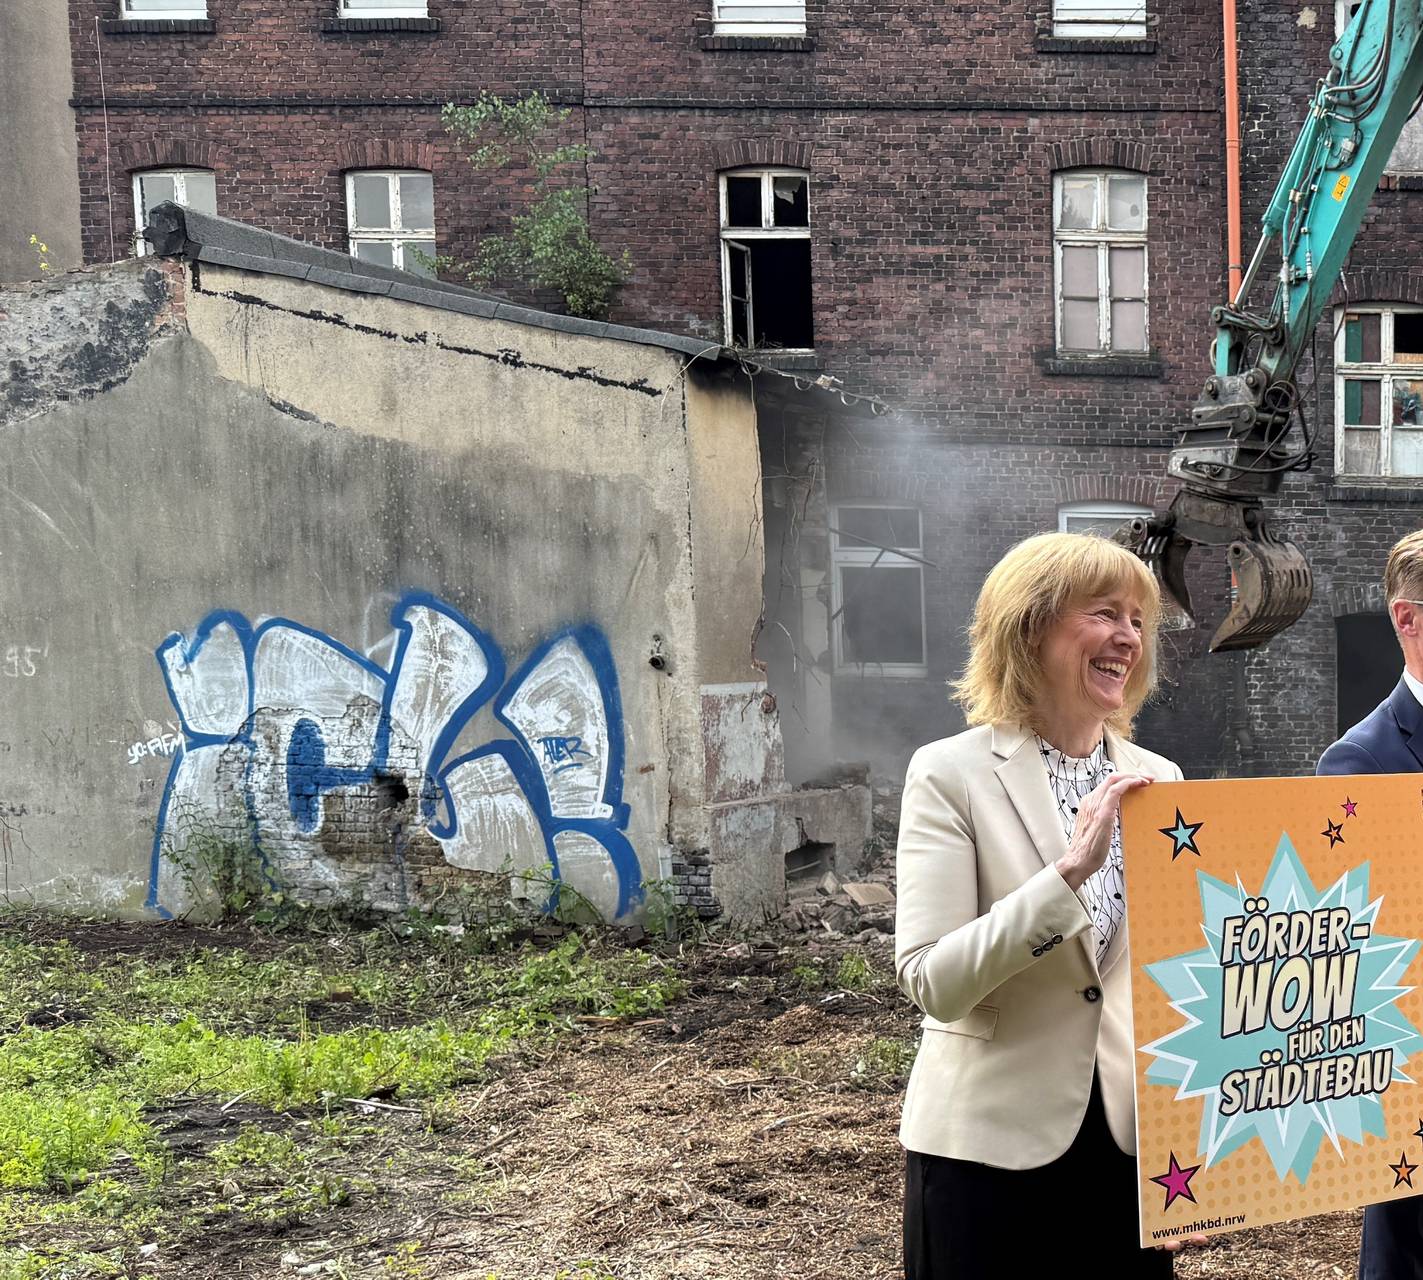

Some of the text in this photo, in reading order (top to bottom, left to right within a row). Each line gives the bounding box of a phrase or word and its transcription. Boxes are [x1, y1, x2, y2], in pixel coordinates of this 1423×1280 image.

[1220, 897, 1371, 966] FÖRDER-
[1221, 949, 1360, 1039] WOW
[1287, 1014, 1366, 1062] FÜR DEN
[1219, 1048, 1394, 1116] STÄDTEBAU
[1152, 1213, 1246, 1240] www.mhkbd.nrw
